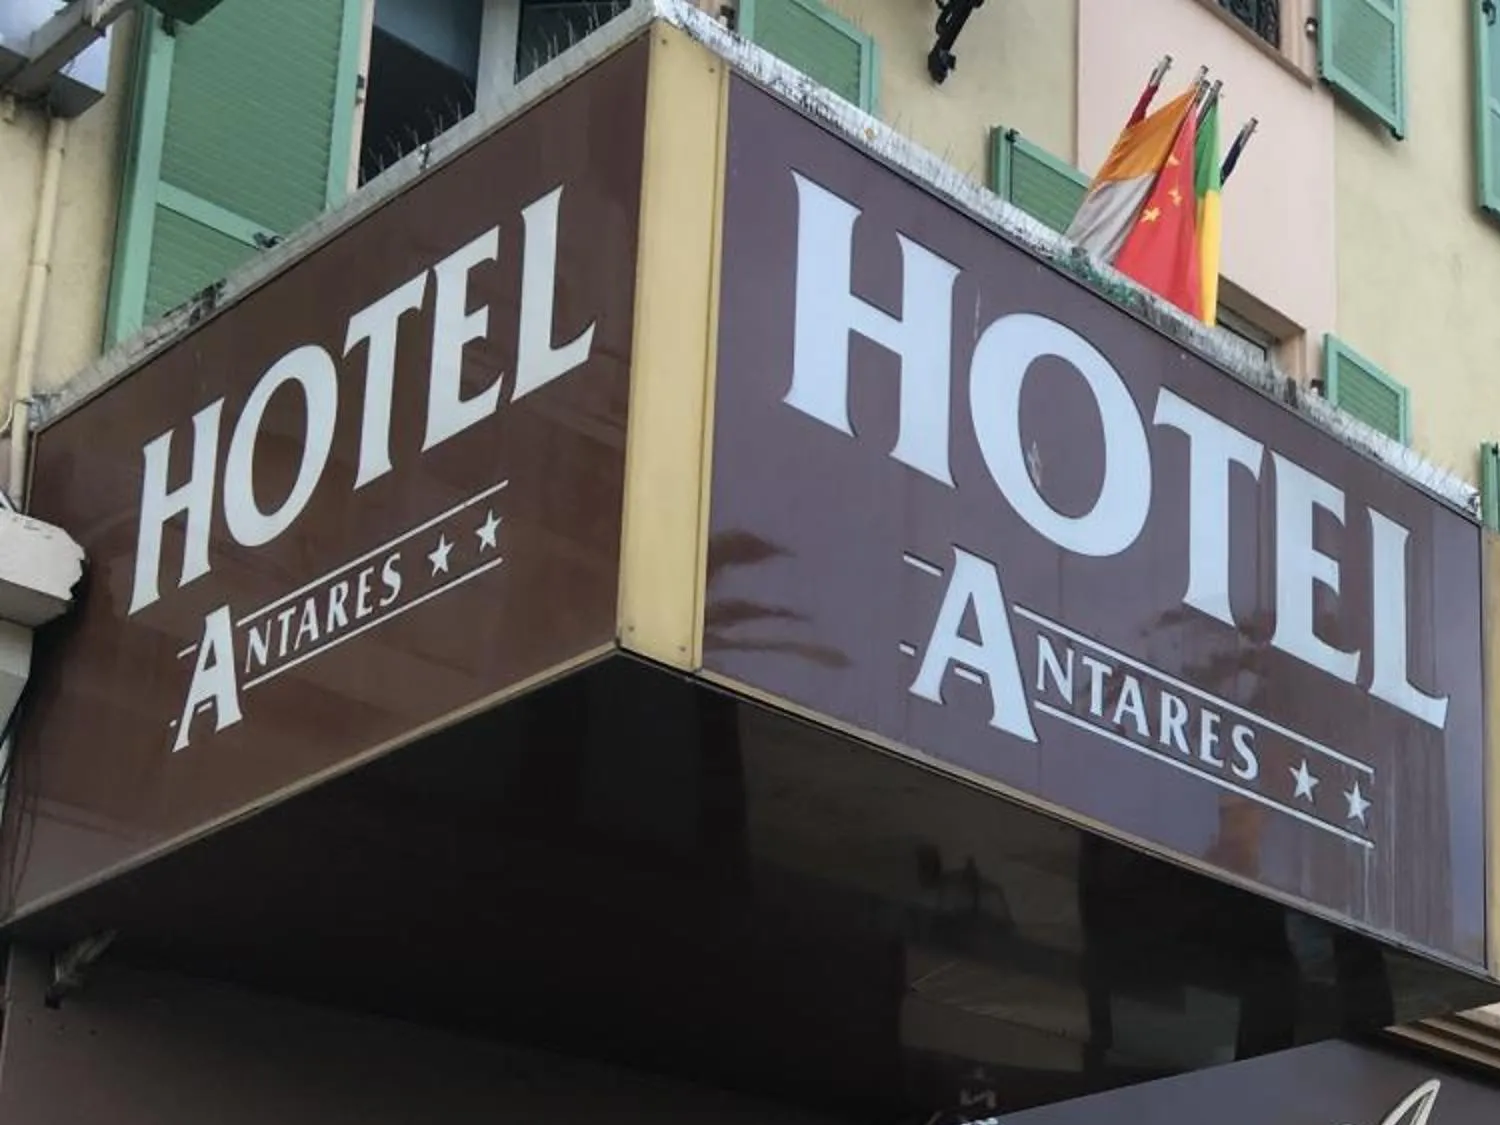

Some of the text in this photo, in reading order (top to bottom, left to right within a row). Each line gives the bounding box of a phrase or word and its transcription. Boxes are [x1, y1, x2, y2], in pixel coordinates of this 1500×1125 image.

[128, 184, 596, 616] HOTEL
[784, 170, 1449, 729] HOTEL
[172, 554, 402, 753] ANTARES
[909, 545, 1260, 781] ANTARES
